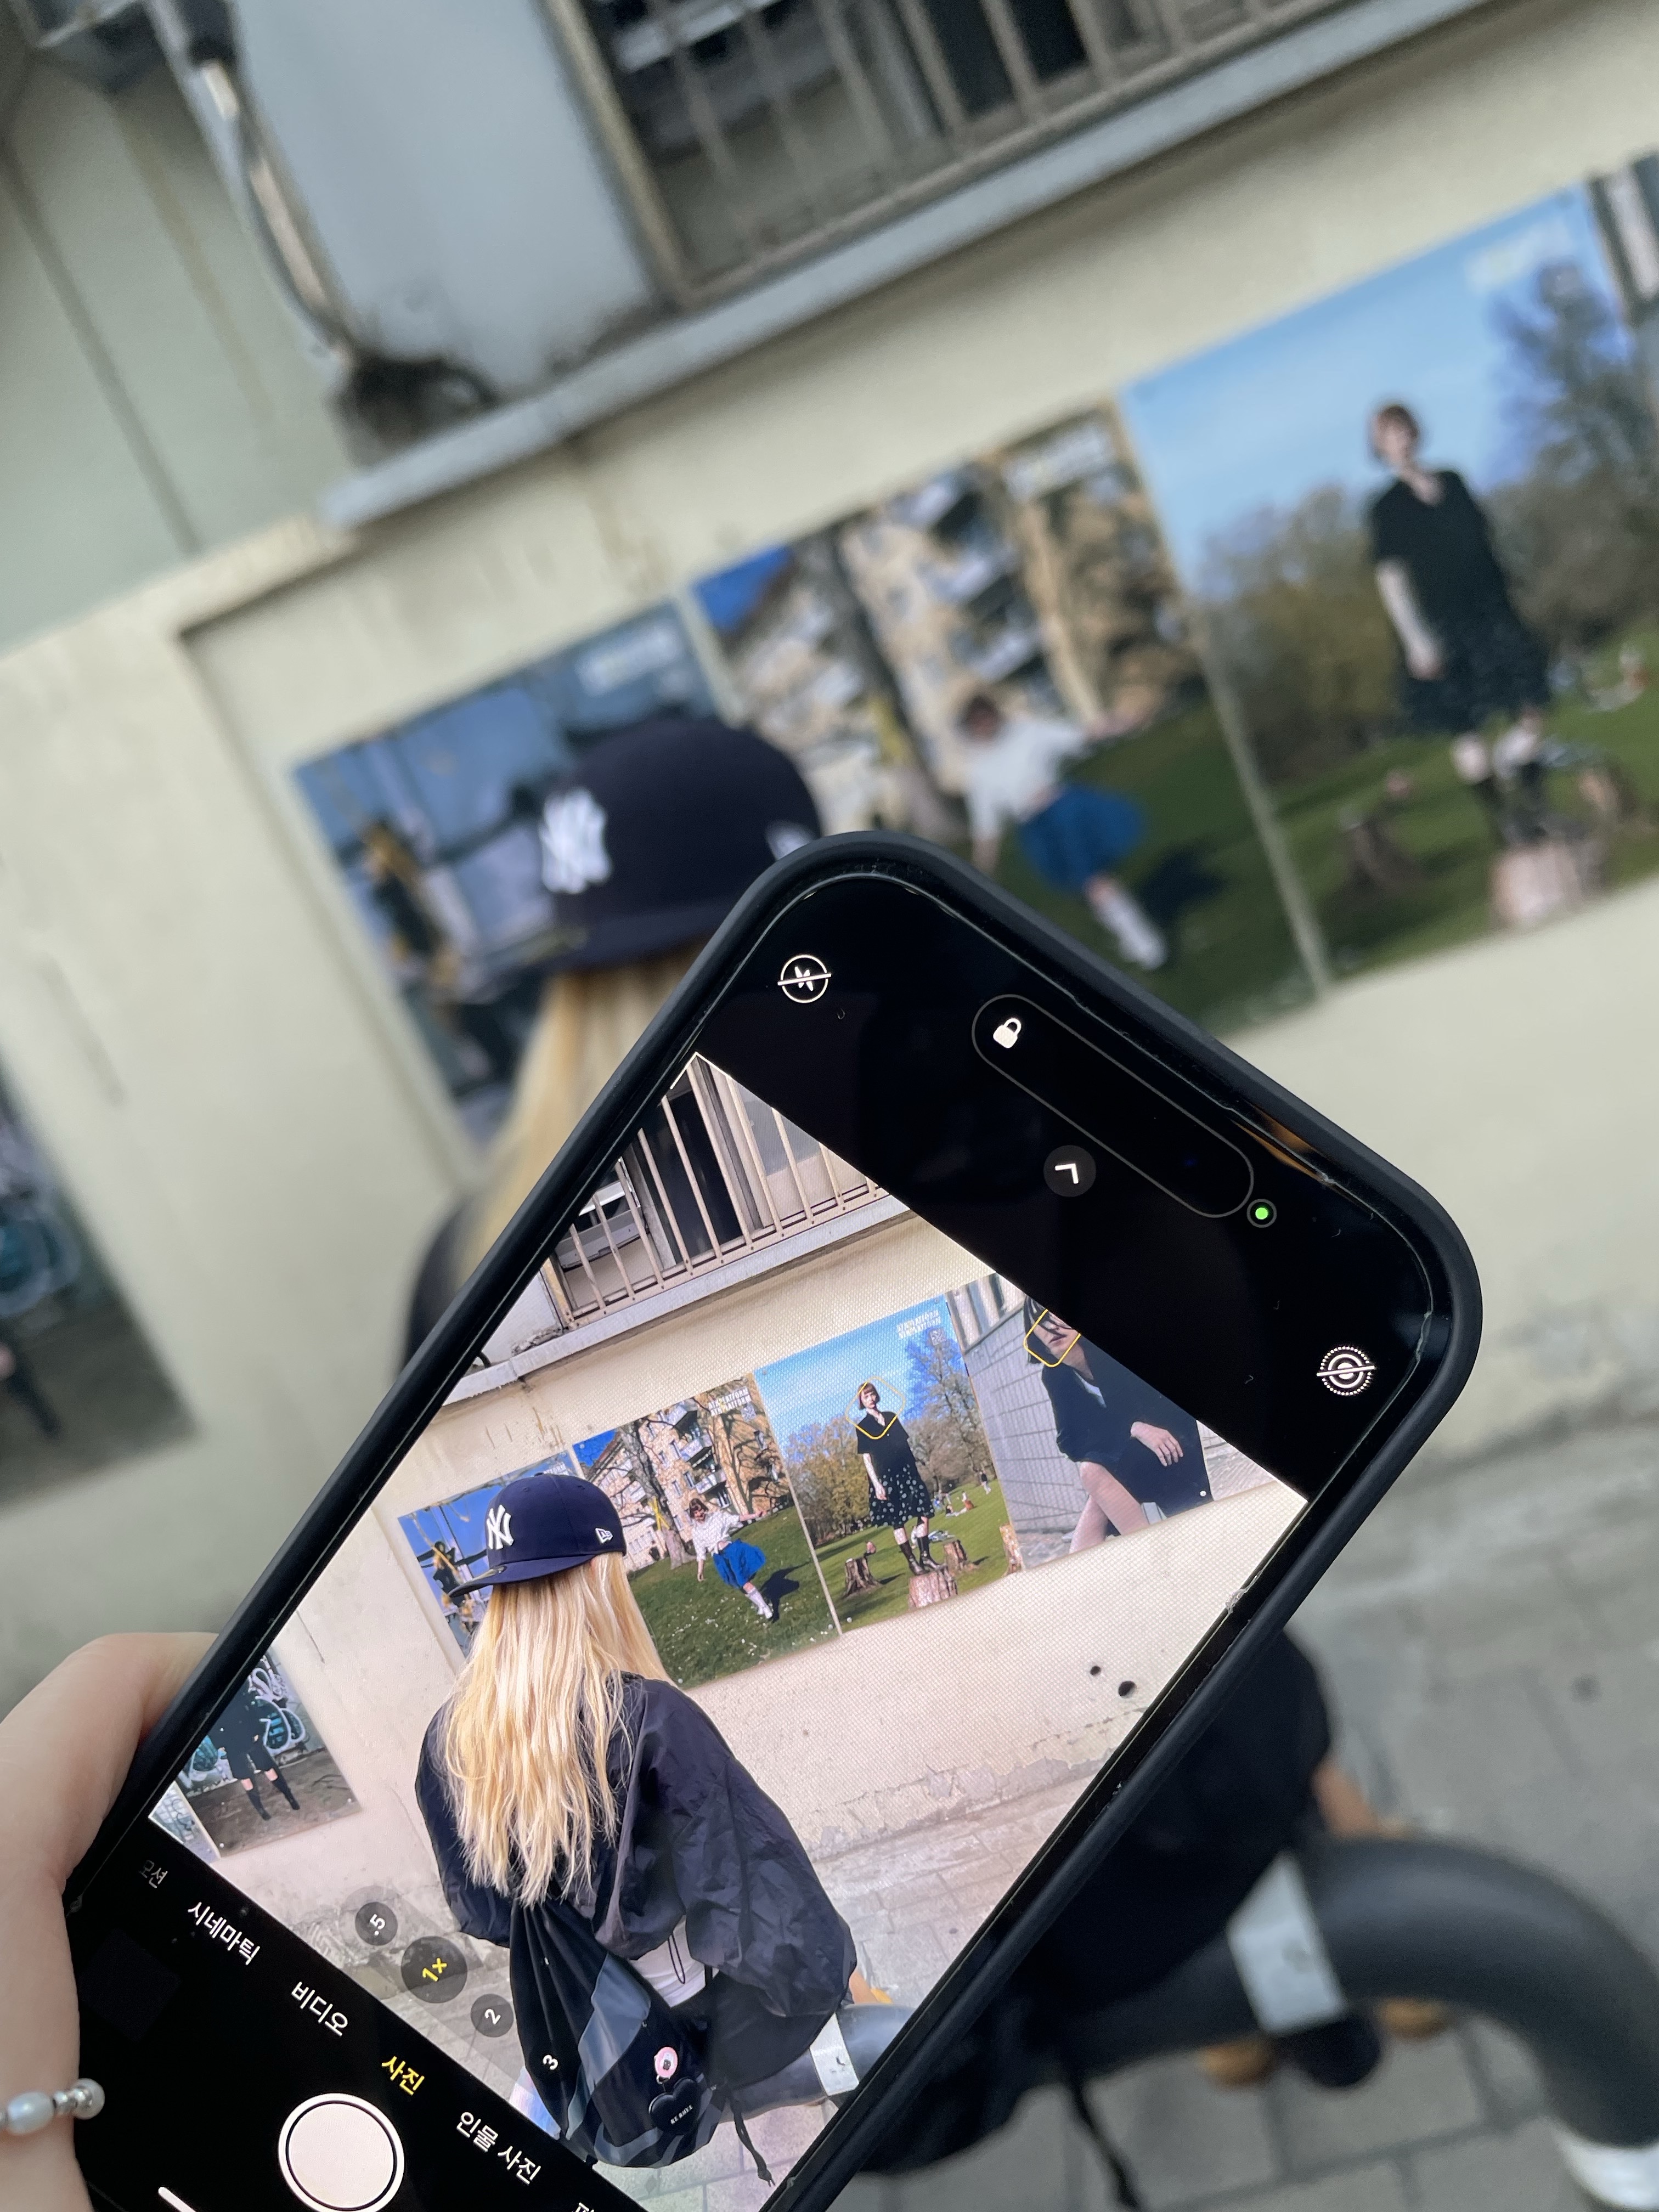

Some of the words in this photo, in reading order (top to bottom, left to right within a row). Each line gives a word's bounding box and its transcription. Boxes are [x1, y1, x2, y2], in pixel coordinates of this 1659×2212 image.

[486, 1504, 514, 1550] NY
[139, 1860, 168, 1888] 모션
[187, 1901, 261, 1965] 시네마틱
[291, 1981, 348, 2036] 비디오
[381, 2056, 425, 2096] 사진
[456, 2112, 499, 2153] 인물
[497, 2145, 541, 2185] 사진
[369, 1914, 386, 1936] .5
[484, 2008, 501, 2025] 2
[542, 2054, 558, 2071] 3
